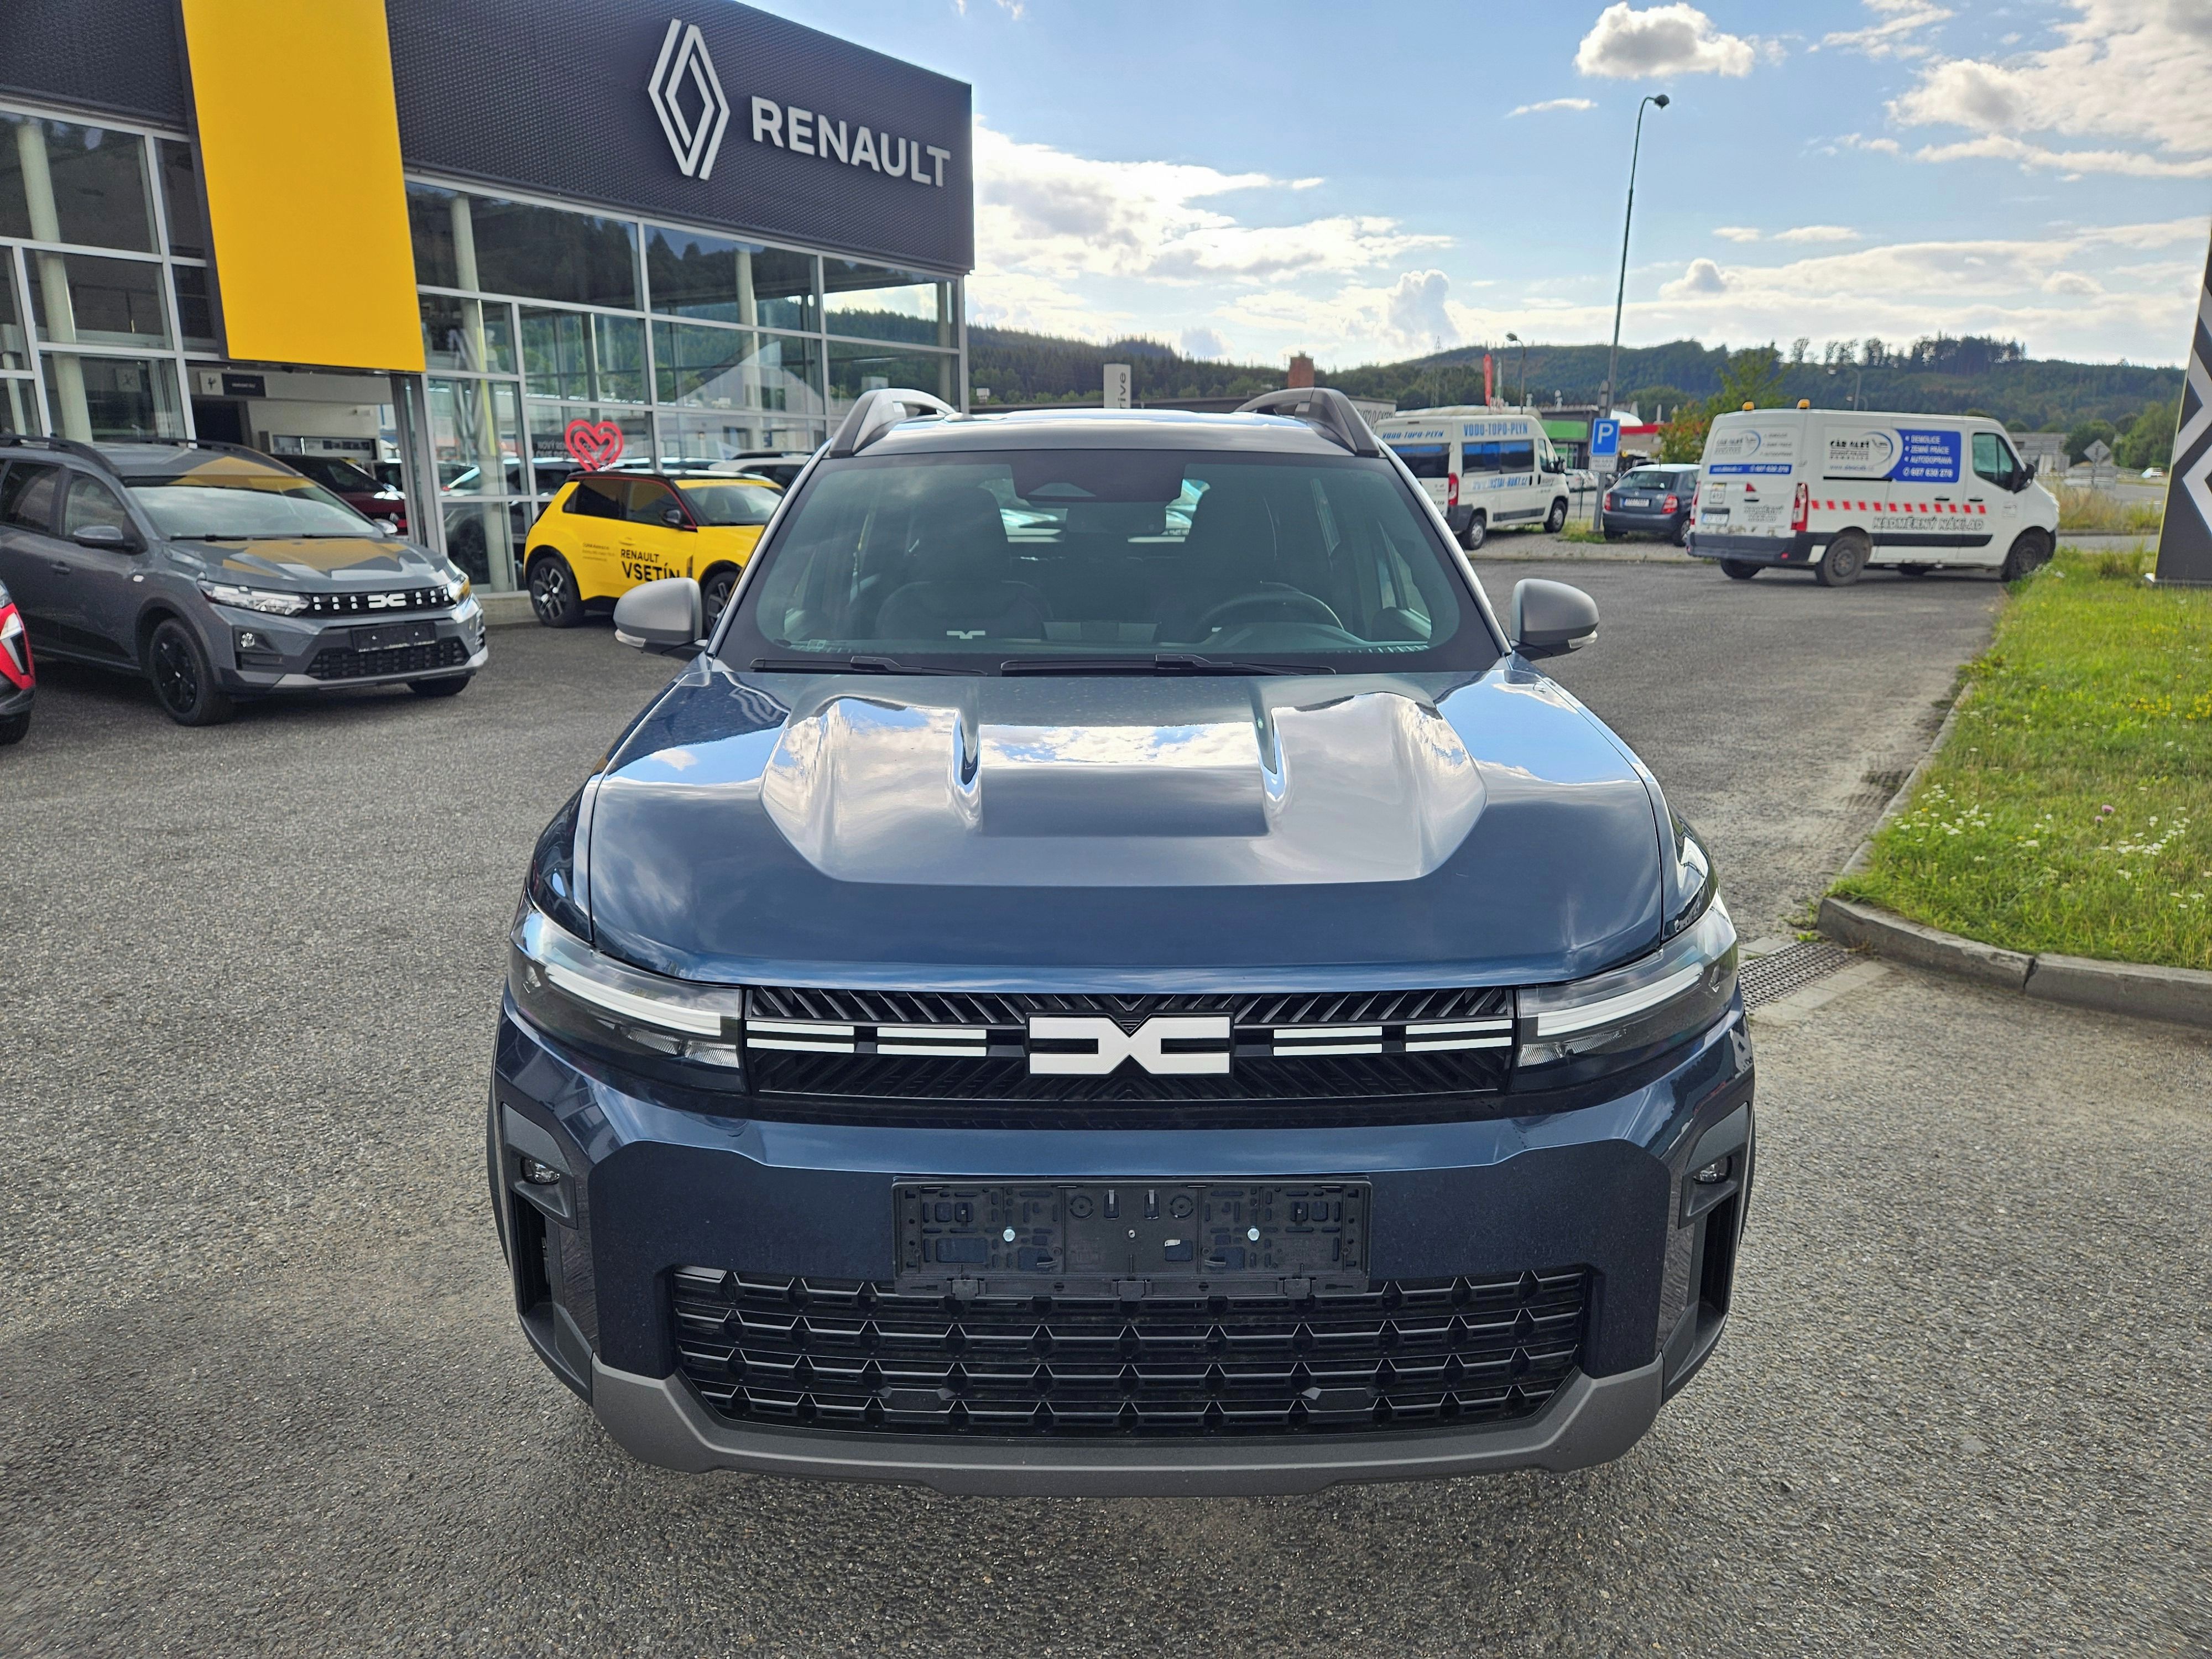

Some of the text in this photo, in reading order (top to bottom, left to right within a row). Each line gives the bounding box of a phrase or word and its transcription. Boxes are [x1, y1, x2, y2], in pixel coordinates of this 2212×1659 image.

[751, 95, 951, 187] RENAULT
[1597, 422, 1614, 445] P
[620, 549, 660, 564] RENAULT
[621, 562, 680, 582] VSETÍN
